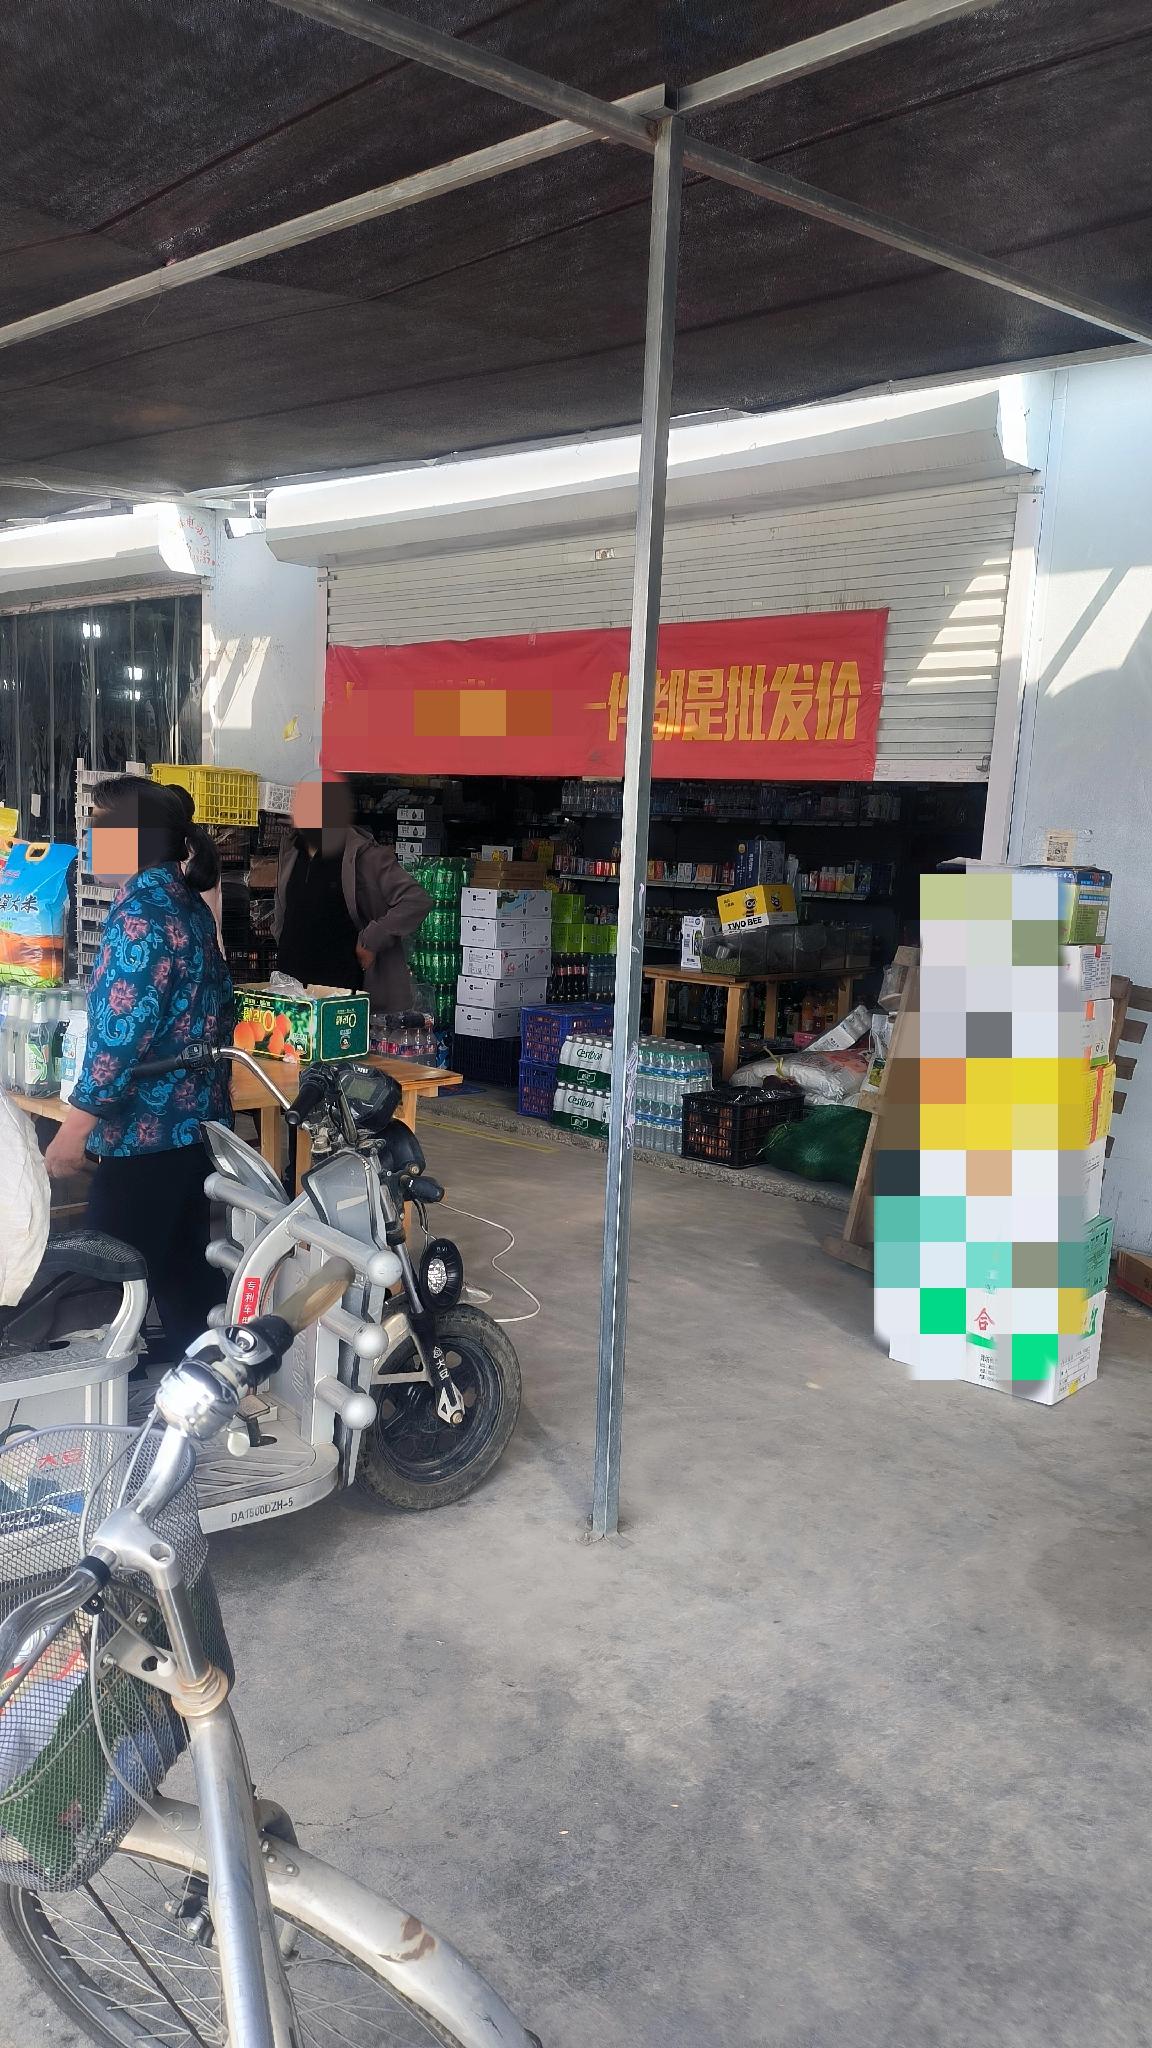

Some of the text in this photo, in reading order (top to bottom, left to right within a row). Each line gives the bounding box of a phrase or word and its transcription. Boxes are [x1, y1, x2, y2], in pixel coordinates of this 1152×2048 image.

[727, 916, 762, 931] TWO BEE
[231, 1496, 294, 1523] DA1500DZH-5
